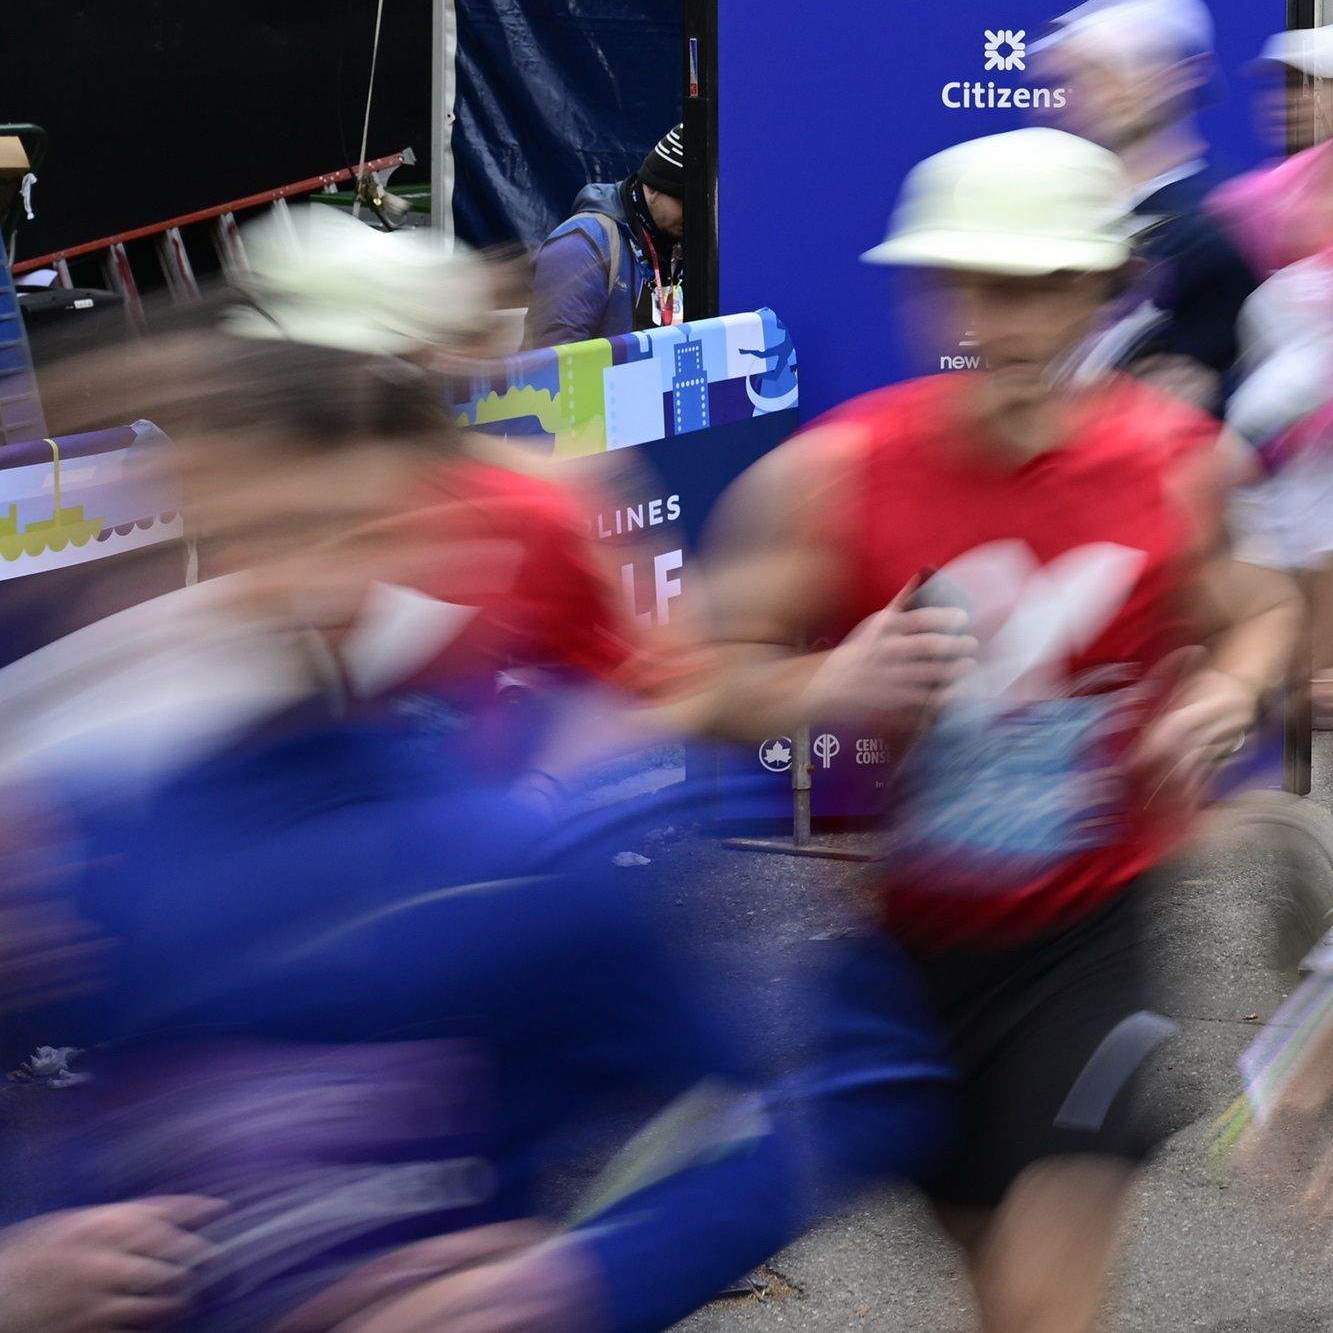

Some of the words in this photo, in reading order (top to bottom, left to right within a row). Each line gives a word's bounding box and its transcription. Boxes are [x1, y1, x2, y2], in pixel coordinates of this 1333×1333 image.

[940, 355, 980, 369] new
[598, 494, 681, 539] LINES
[621, 549, 683, 628] LF
